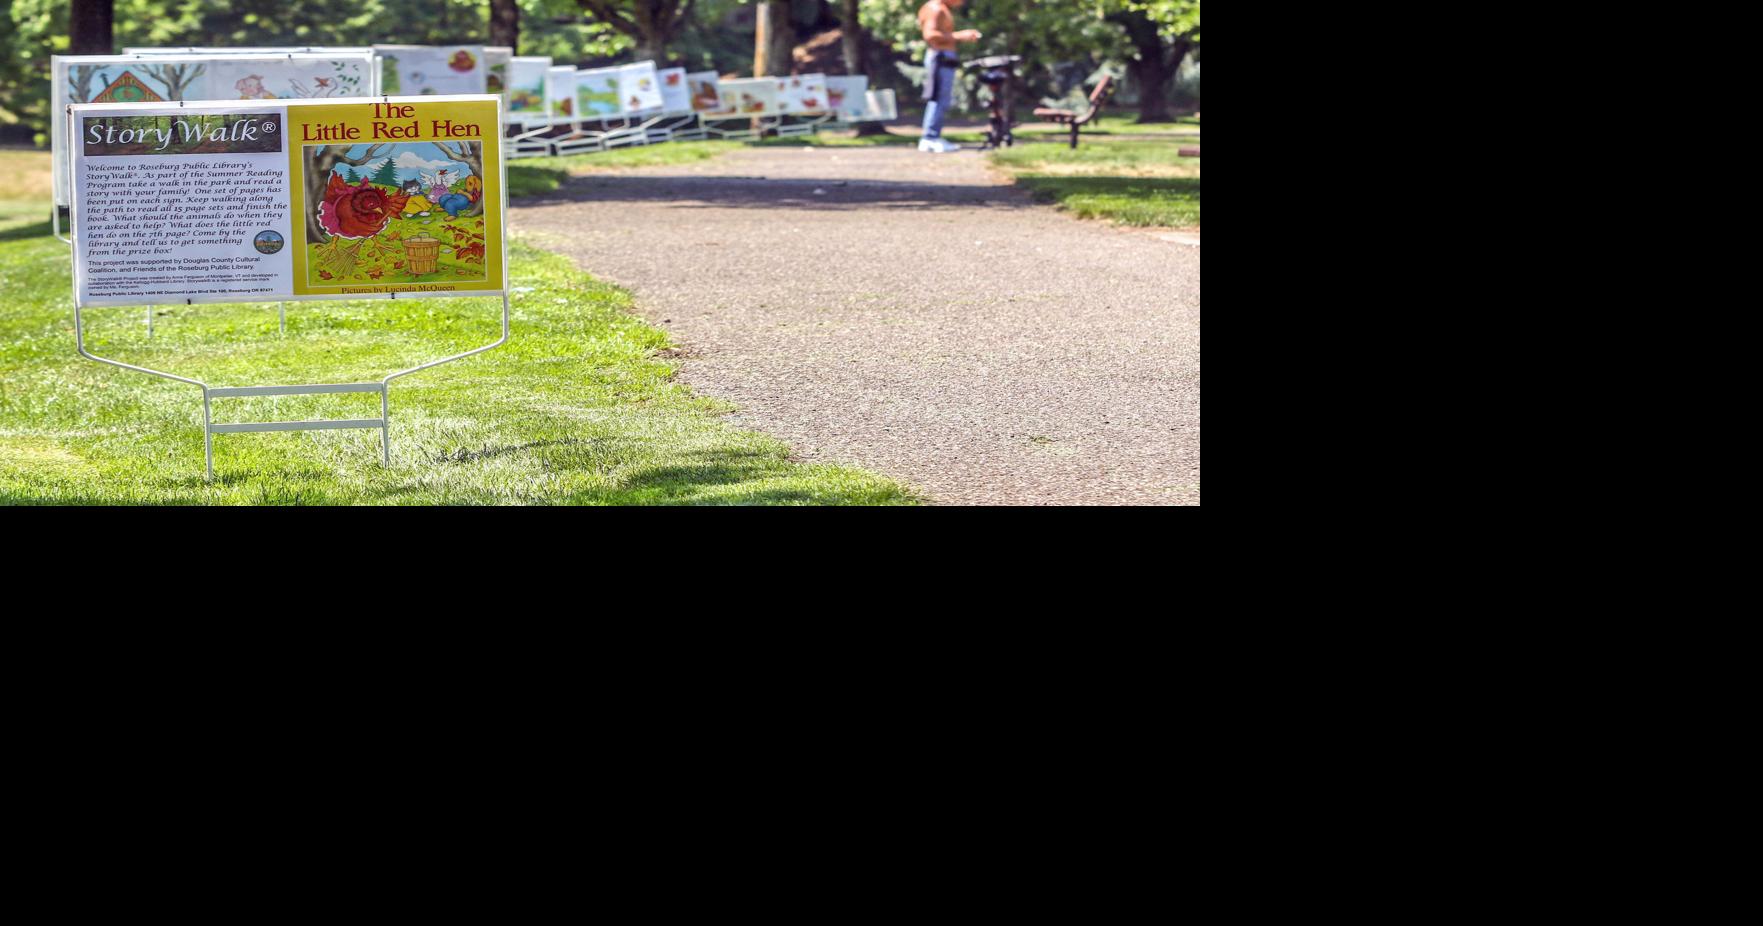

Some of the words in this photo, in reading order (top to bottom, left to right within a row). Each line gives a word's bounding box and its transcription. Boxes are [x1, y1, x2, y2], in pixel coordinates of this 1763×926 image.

[369, 102, 415, 118] The
[86, 119, 276, 150] StoryWalk®
[302, 122, 360, 141] Little
[372, 122, 419, 139] Red
[432, 120, 481, 137] Hen
[139, 163, 179, 172] Roseburg
[213, 161, 252, 170] Library's
[180, 171, 188, 179] of
[247, 169, 283, 178] Reading
[87, 181, 125, 189] Program
[210, 178, 231, 187] park
[158, 188, 189, 197] family!
[229, 187, 237, 195] of
[186, 196, 209, 204] Keep
[212, 195, 246, 204] walking
[249, 195, 273, 203] along
[103, 206, 123, 214] path
[246, 203, 271, 211] finish
[264, 211, 282, 220] they
[143, 222, 166, 230] help?
[149, 230, 162, 239] 7th
[165, 230, 190, 238] page?
[219, 229, 229, 237] by
[89, 240, 119, 248] library
[198, 237, 242, 246] something
[87, 248, 109, 257] from
